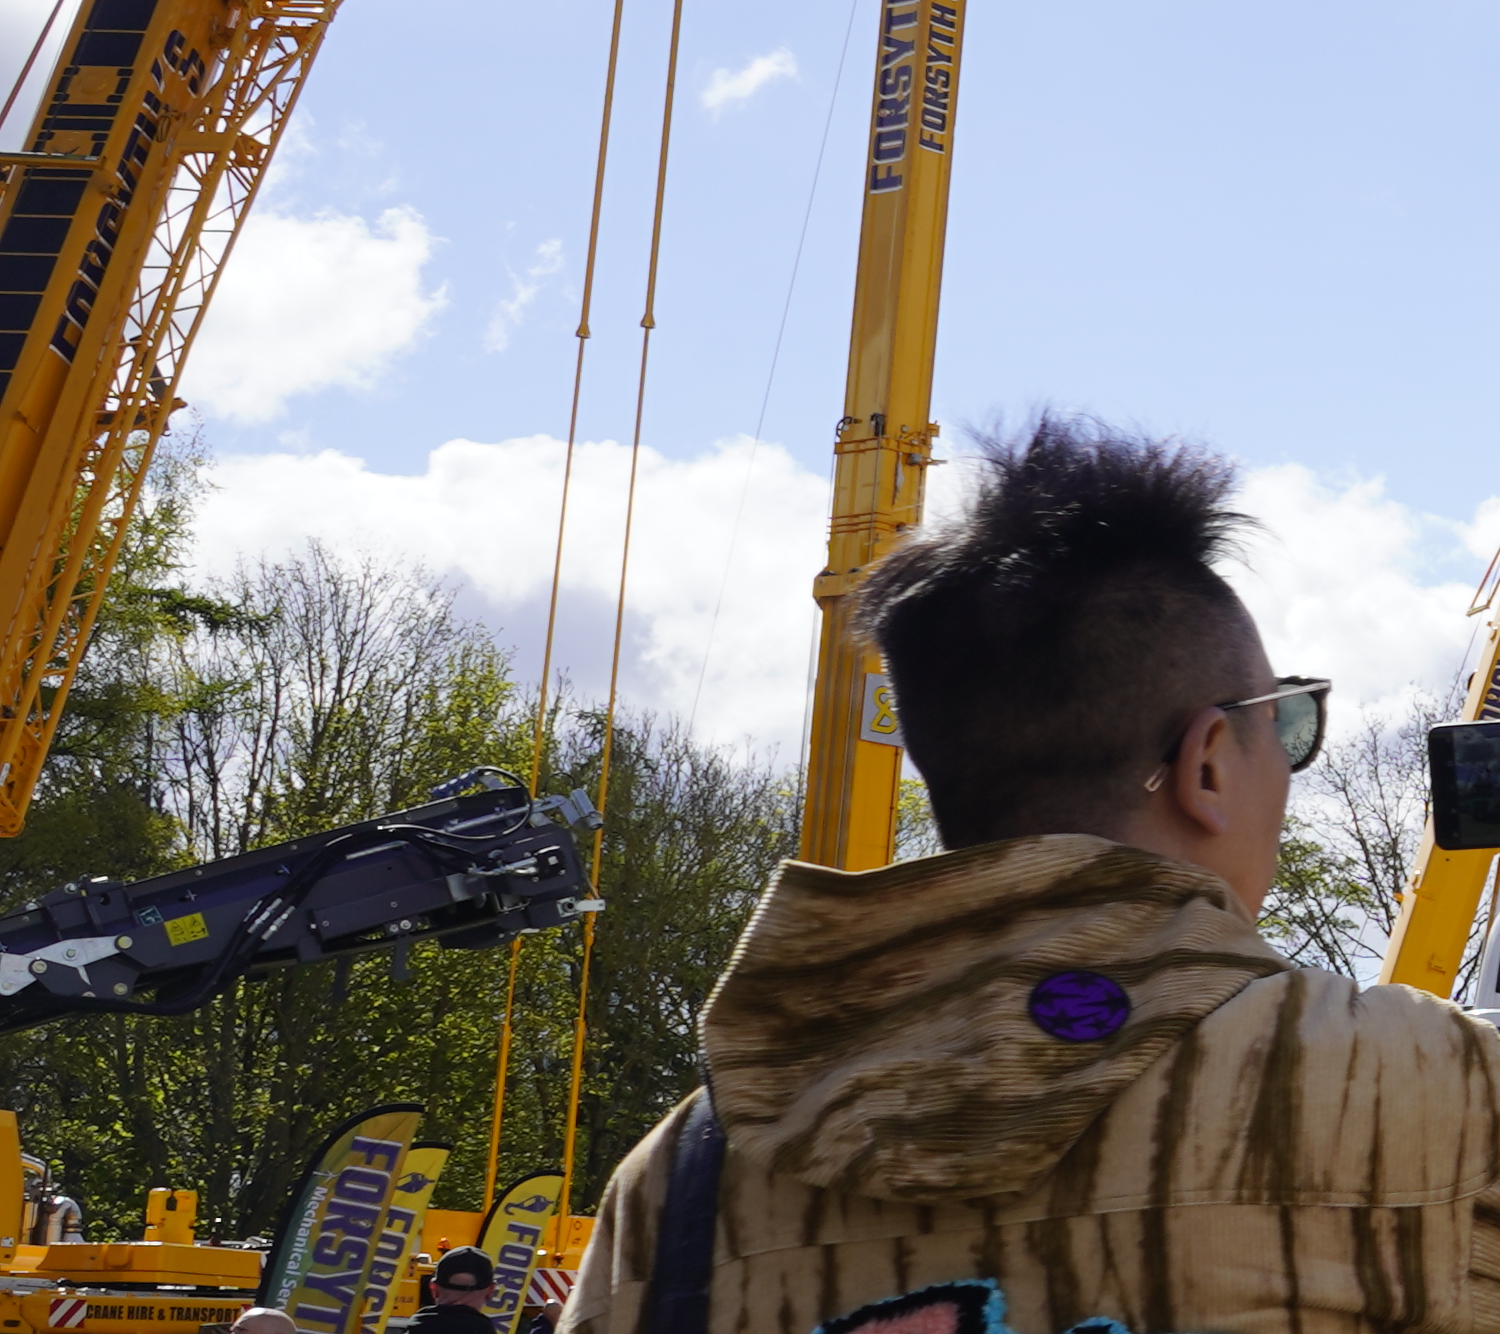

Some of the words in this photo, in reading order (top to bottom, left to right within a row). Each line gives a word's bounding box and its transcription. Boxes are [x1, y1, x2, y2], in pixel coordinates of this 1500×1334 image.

[285, 1186, 329, 1276] Mechanical
[86, 1305, 124, 1319] CRANE
[127, 1306, 154, 1320] HIRE
[169, 1307, 240, 1322] TRANSPORT
